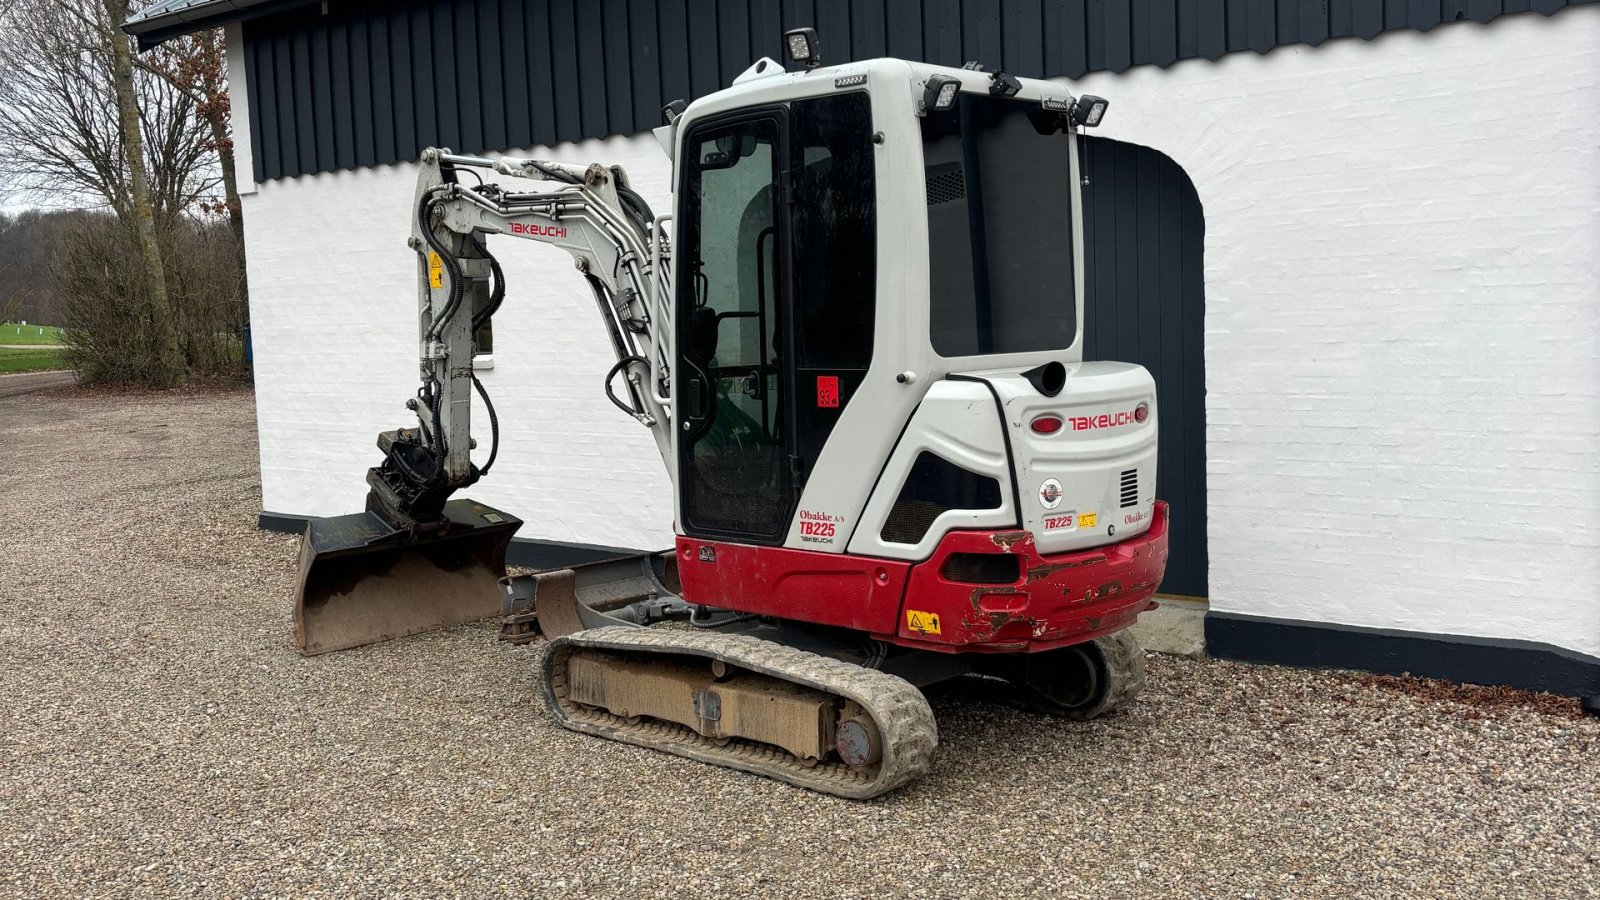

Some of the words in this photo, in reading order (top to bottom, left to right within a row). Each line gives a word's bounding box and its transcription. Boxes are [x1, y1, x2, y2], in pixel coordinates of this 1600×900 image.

[508, 222, 567, 238] TAKEUCHI
[820, 390, 830, 405] 93
[1068, 411, 1135, 430] TAKEUCHI
[800, 521, 835, 537] TB225
[1045, 516, 1072, 529] TB225
